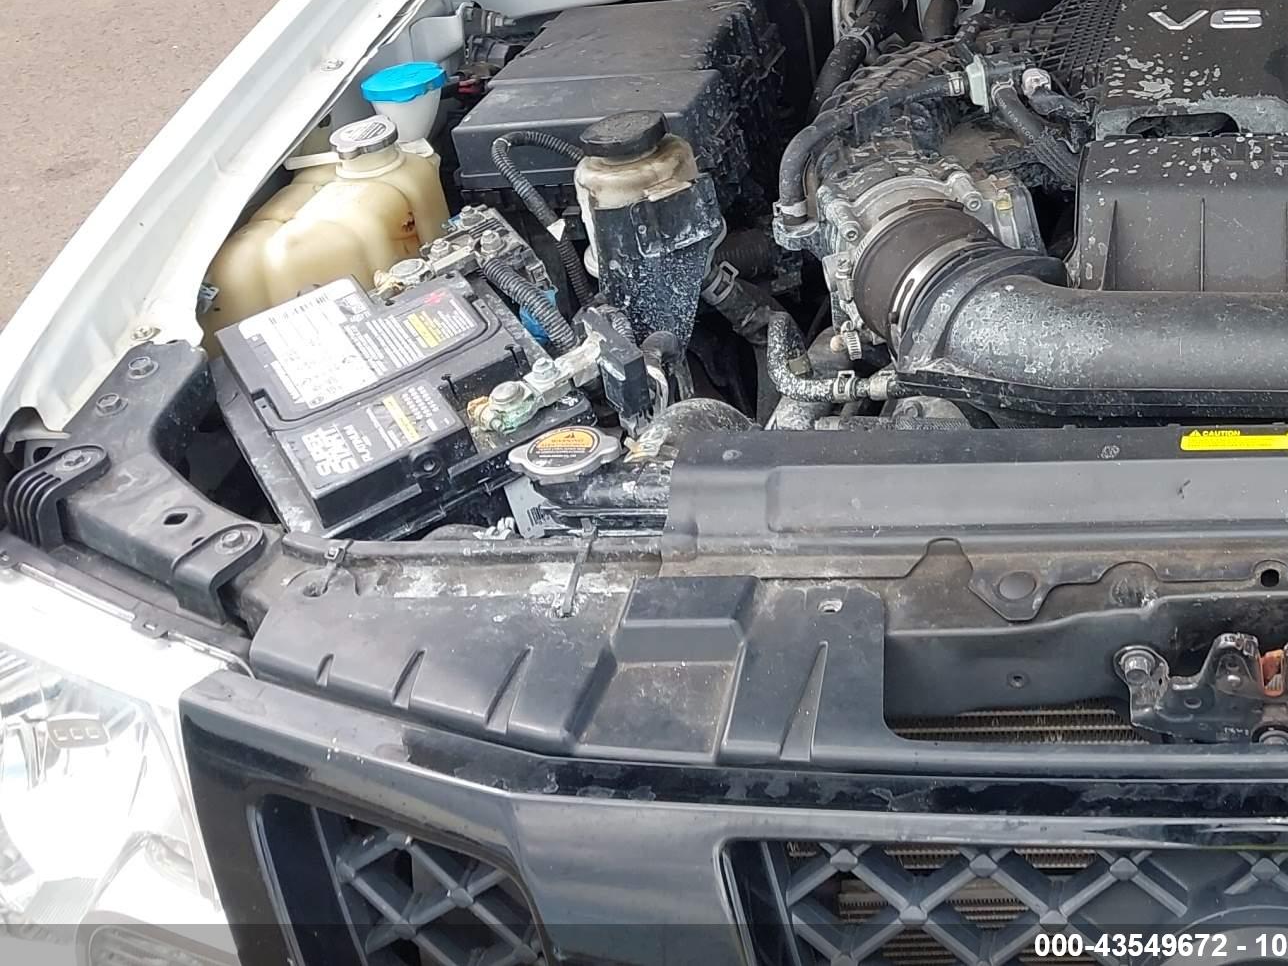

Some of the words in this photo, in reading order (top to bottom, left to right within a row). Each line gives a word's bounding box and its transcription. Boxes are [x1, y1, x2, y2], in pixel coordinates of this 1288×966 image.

[1147, 8, 1263, 31] V6
[301, 427, 334, 477] SUPER
[321, 424, 360, 475] START
